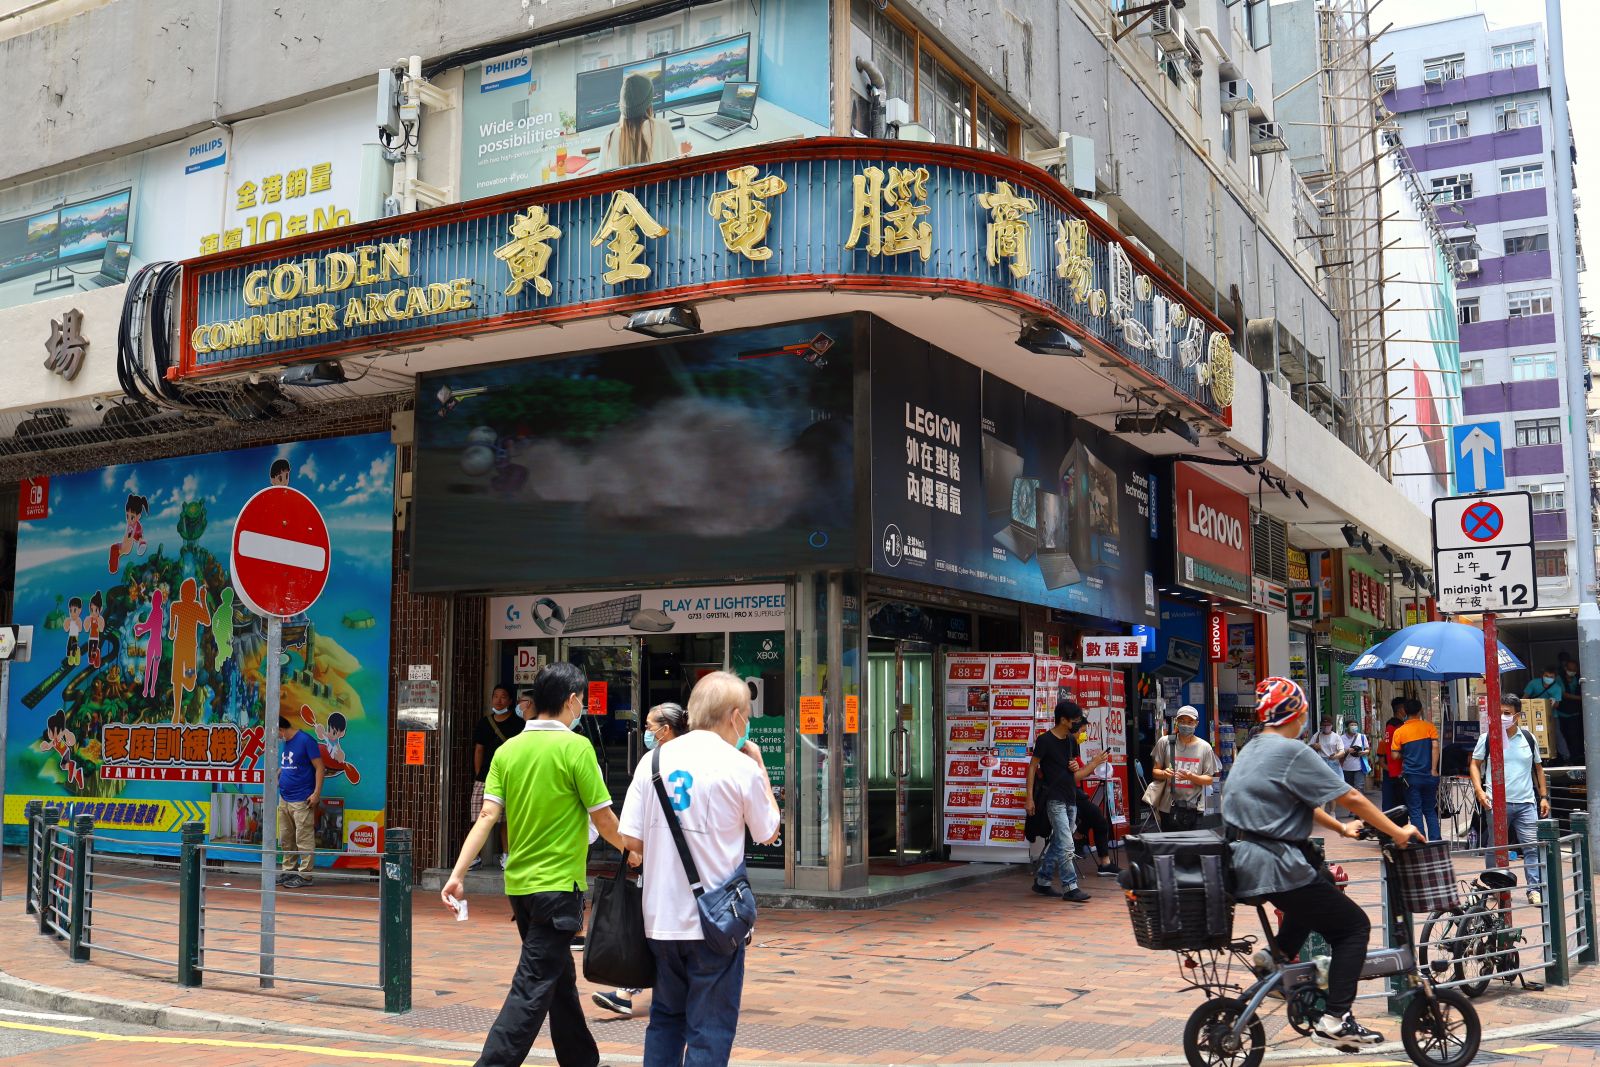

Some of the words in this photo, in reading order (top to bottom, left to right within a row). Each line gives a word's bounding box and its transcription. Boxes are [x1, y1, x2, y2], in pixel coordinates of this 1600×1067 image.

[485, 56, 528, 75] PHILIPS
[479, 119, 514, 138] Wide
[517, 112, 553, 129] open
[189, 137, 223, 158] PHILIPS
[235, 161, 333, 211] 全港銷量
[242, 237, 412, 307] GOLDEN
[191, 302, 339, 353] COMPUTER
[343, 278, 475, 327] ARCADE
[905, 402, 961, 447] LEGION
[905, 435, 961, 482] 外在型格
[1187, 489, 1243, 551] Lenovo
[1457, 551, 1474, 560] am
[1496, 550, 1512, 571] 7
[1453, 561, 1480, 574] 上午
[1443, 583, 1493, 594] midnight
[1499, 584, 1528, 606] 12
[663, 598, 692, 611] PLAY
[695, 598, 711, 610] AT
[1455, 596, 1482, 608] 午夜
[1211, 616, 1221, 659] Lenovo
[756, 652, 779, 660] XBOX
[1085, 641, 1139, 657] 數碼通
[104, 726, 240, 763] 家庭訓練機
[760, 735, 781, 743] Series
[105, 767, 167, 779] FAMILY
[181, 769, 261, 783] TRAINER
[667, 770, 693, 812] 3
